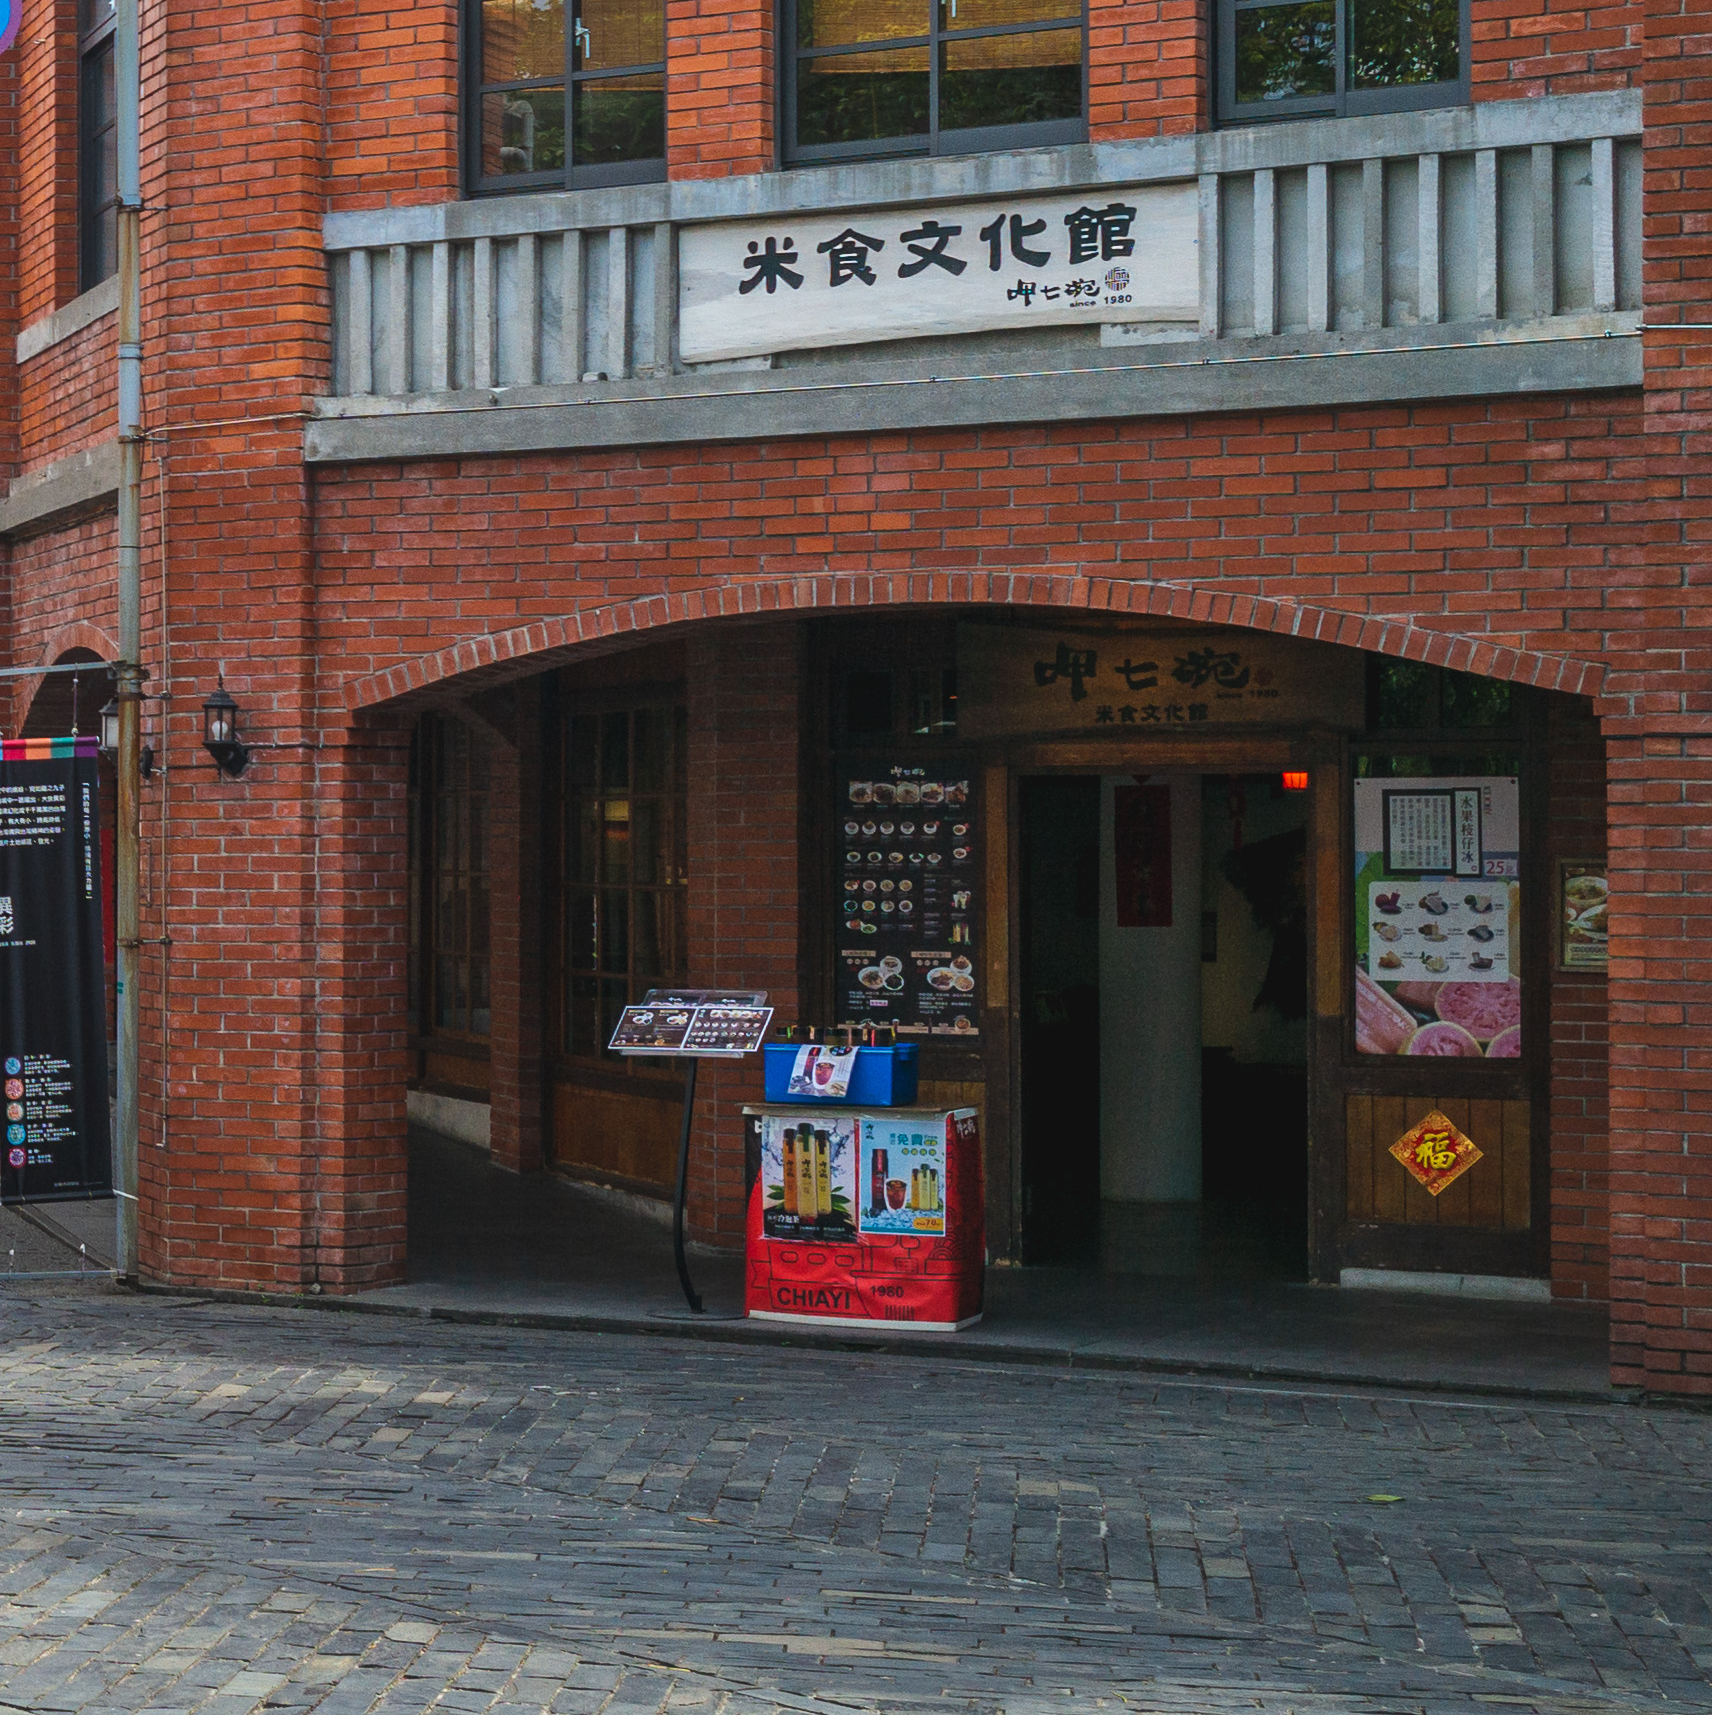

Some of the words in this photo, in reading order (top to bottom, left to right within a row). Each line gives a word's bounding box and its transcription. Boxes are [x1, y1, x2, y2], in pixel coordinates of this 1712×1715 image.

[739, 202, 1137, 294] 米食文化館
[1007, 278, 1100, 307] 呷七碗
[1104, 295, 1133, 304] 1980
[1034, 641, 1250, 702] 呷七碗
[1096, 703, 1208, 723] 米食文化館
[1486, 860, 1504, 874] 25
[1415, 1131, 1457, 1170] 福
[777, 1287, 850, 1310] CHIAYI
[870, 1285, 905, 1298] 1980
